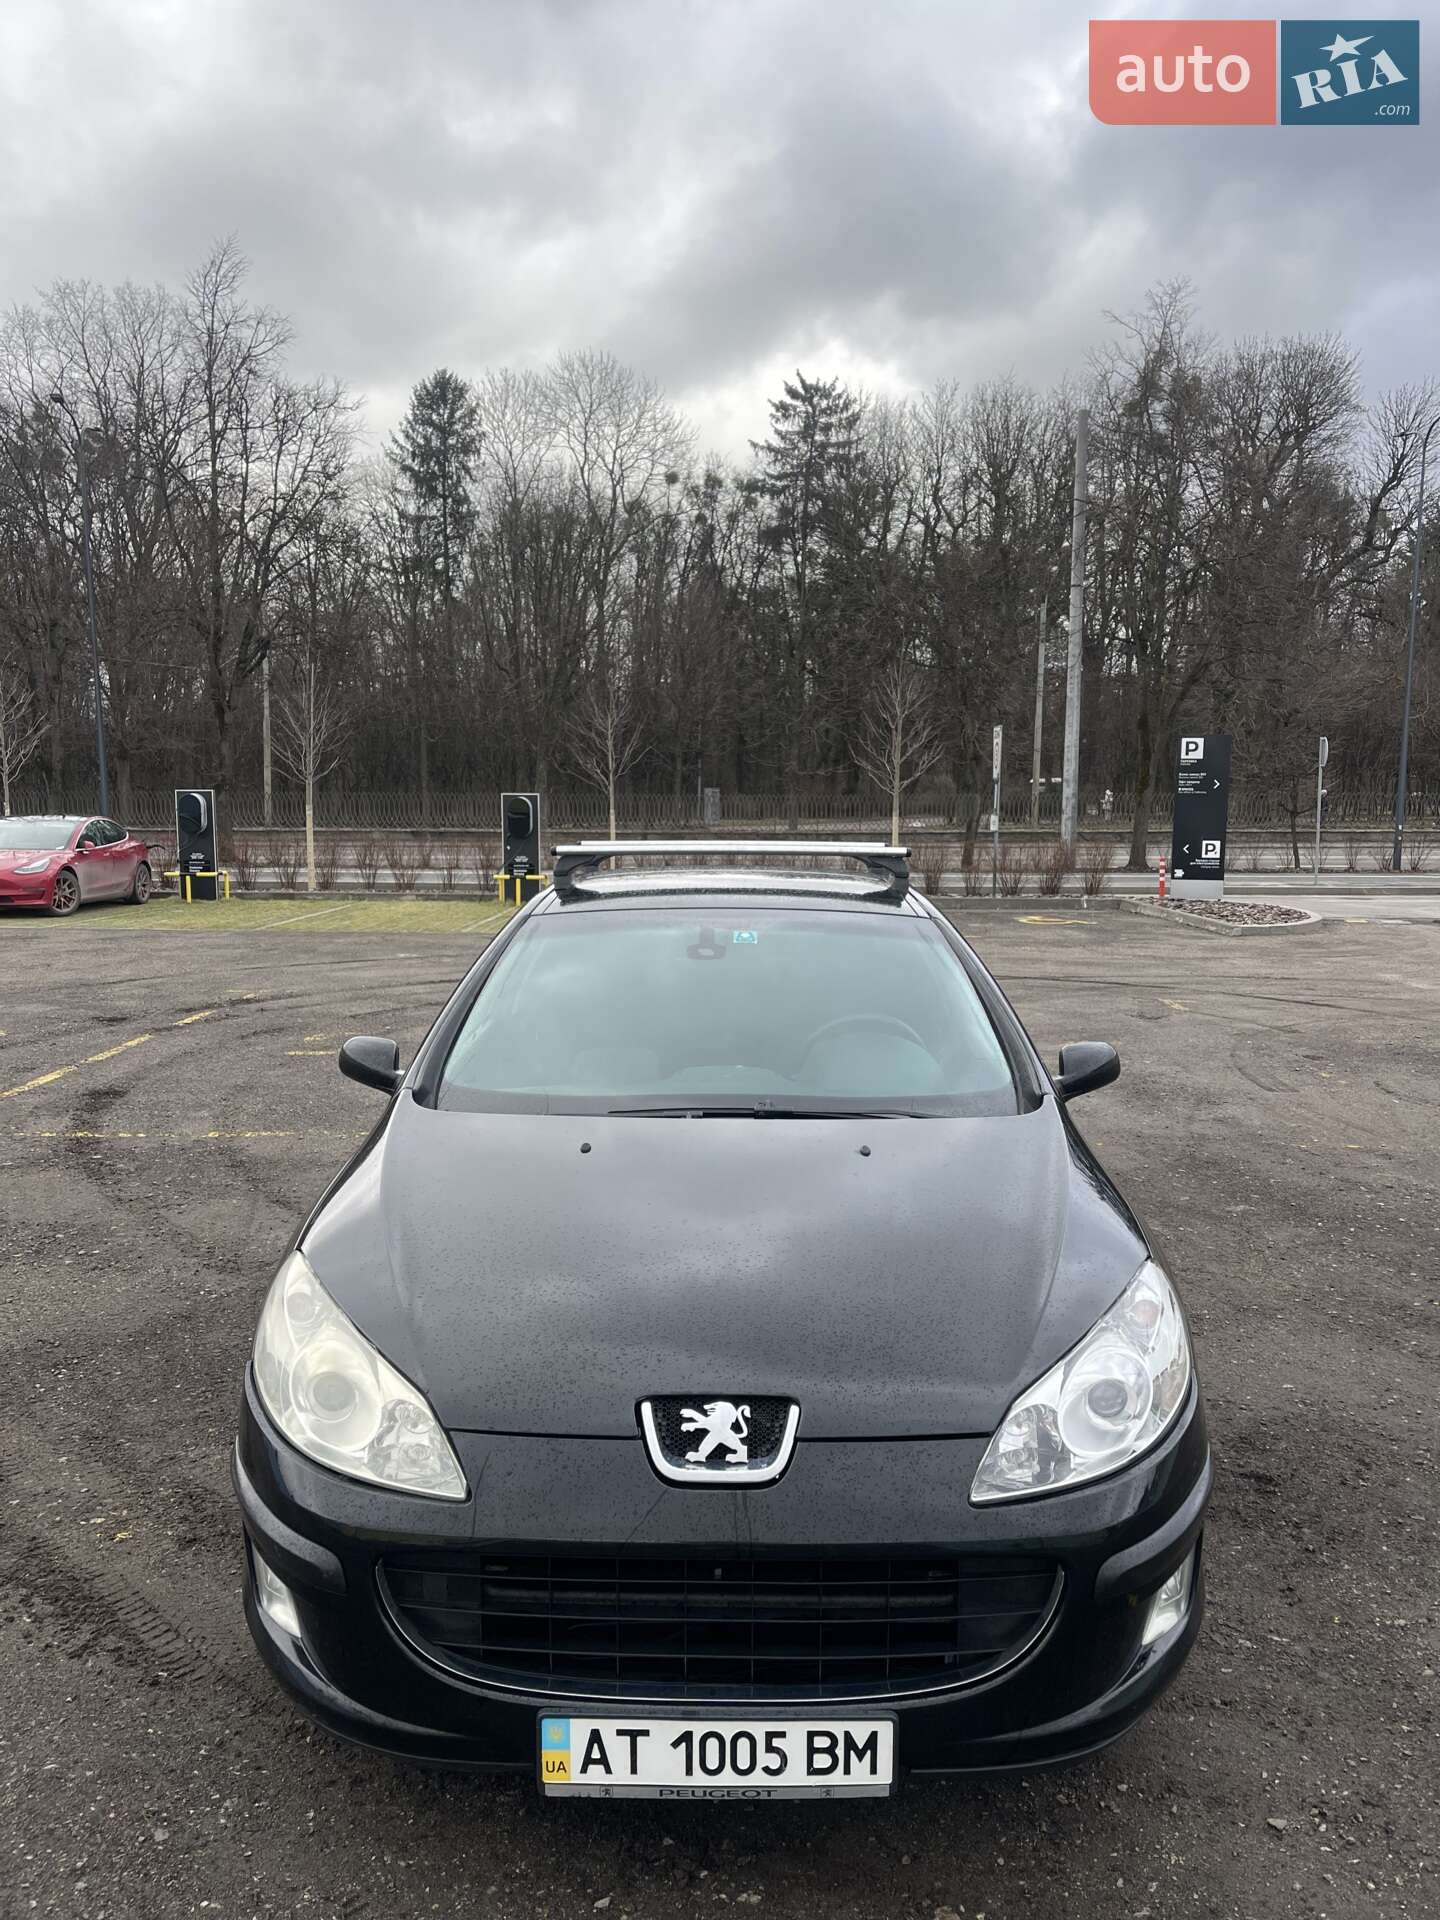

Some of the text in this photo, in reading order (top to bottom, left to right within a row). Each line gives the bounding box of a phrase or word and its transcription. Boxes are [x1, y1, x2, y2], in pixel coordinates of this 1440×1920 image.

[1185, 741, 1199, 756] P
[579, 1728, 879, 1777] AT 1005 BM
[545, 1760, 567, 1774] UA
[659, 1789, 778, 1799] PEUGEOT
